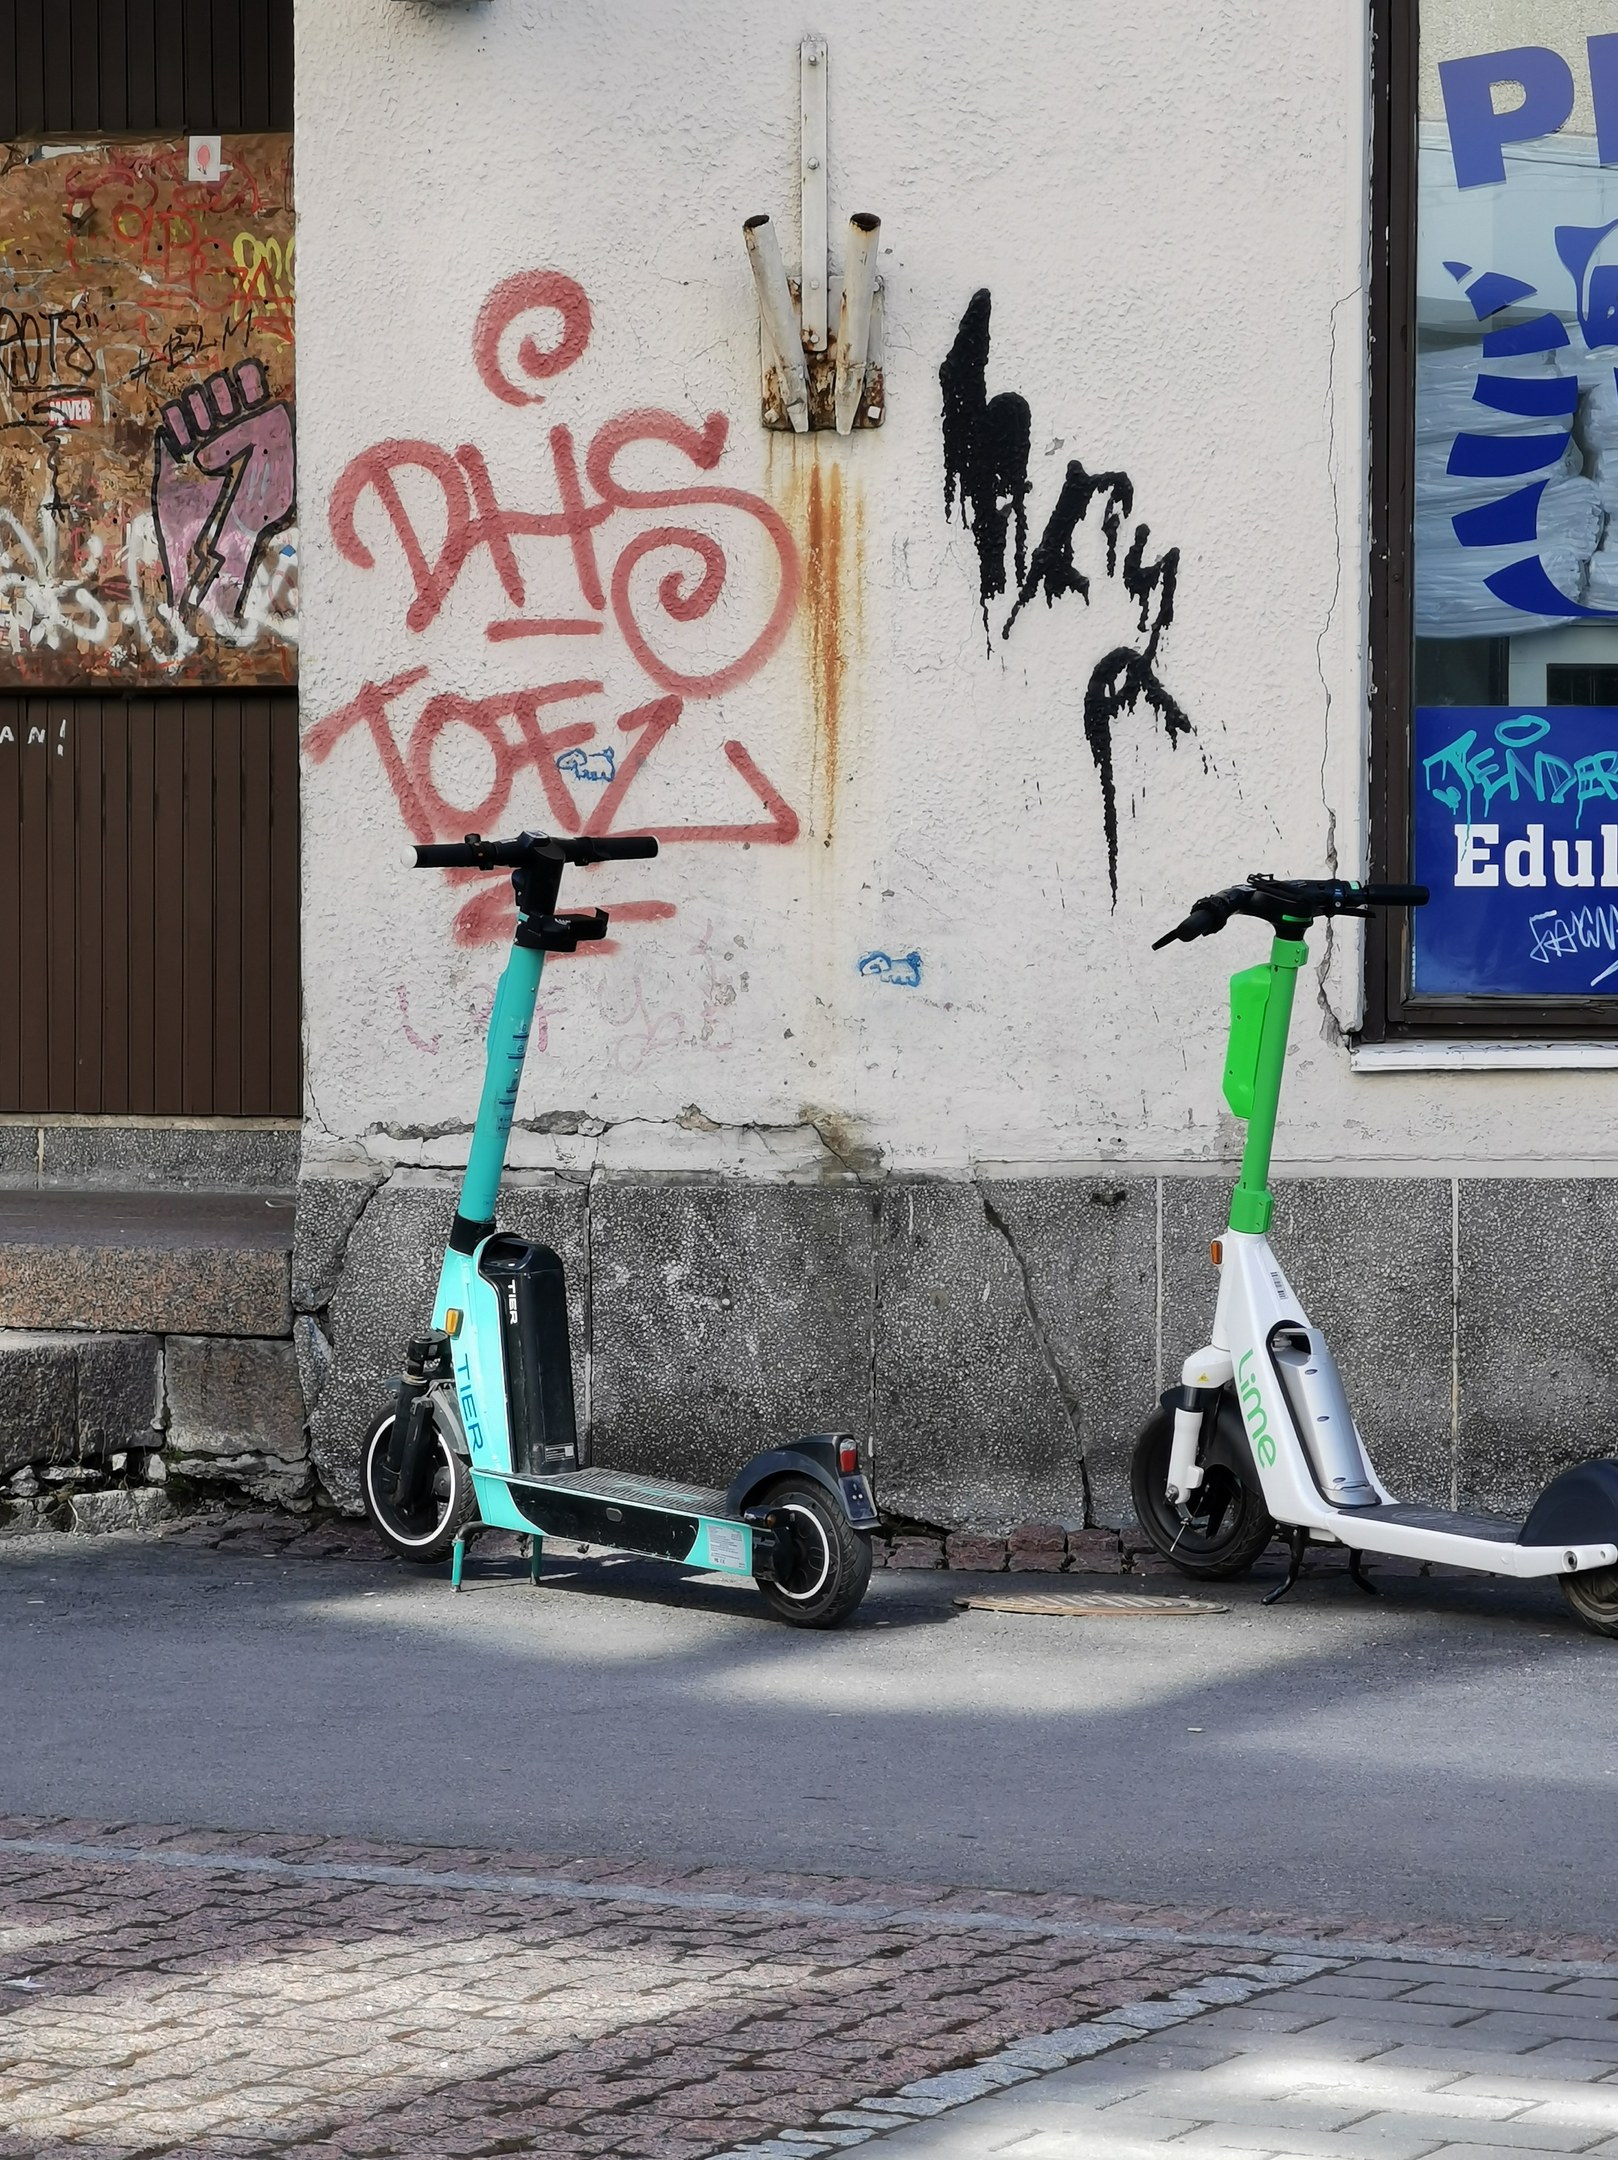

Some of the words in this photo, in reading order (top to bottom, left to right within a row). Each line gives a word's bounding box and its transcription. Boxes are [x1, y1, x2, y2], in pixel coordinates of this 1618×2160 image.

[507, 1279, 518, 1325] TIER
[457, 1353, 484, 1452] TIER
[1238, 1348, 1277, 1470] Lime
